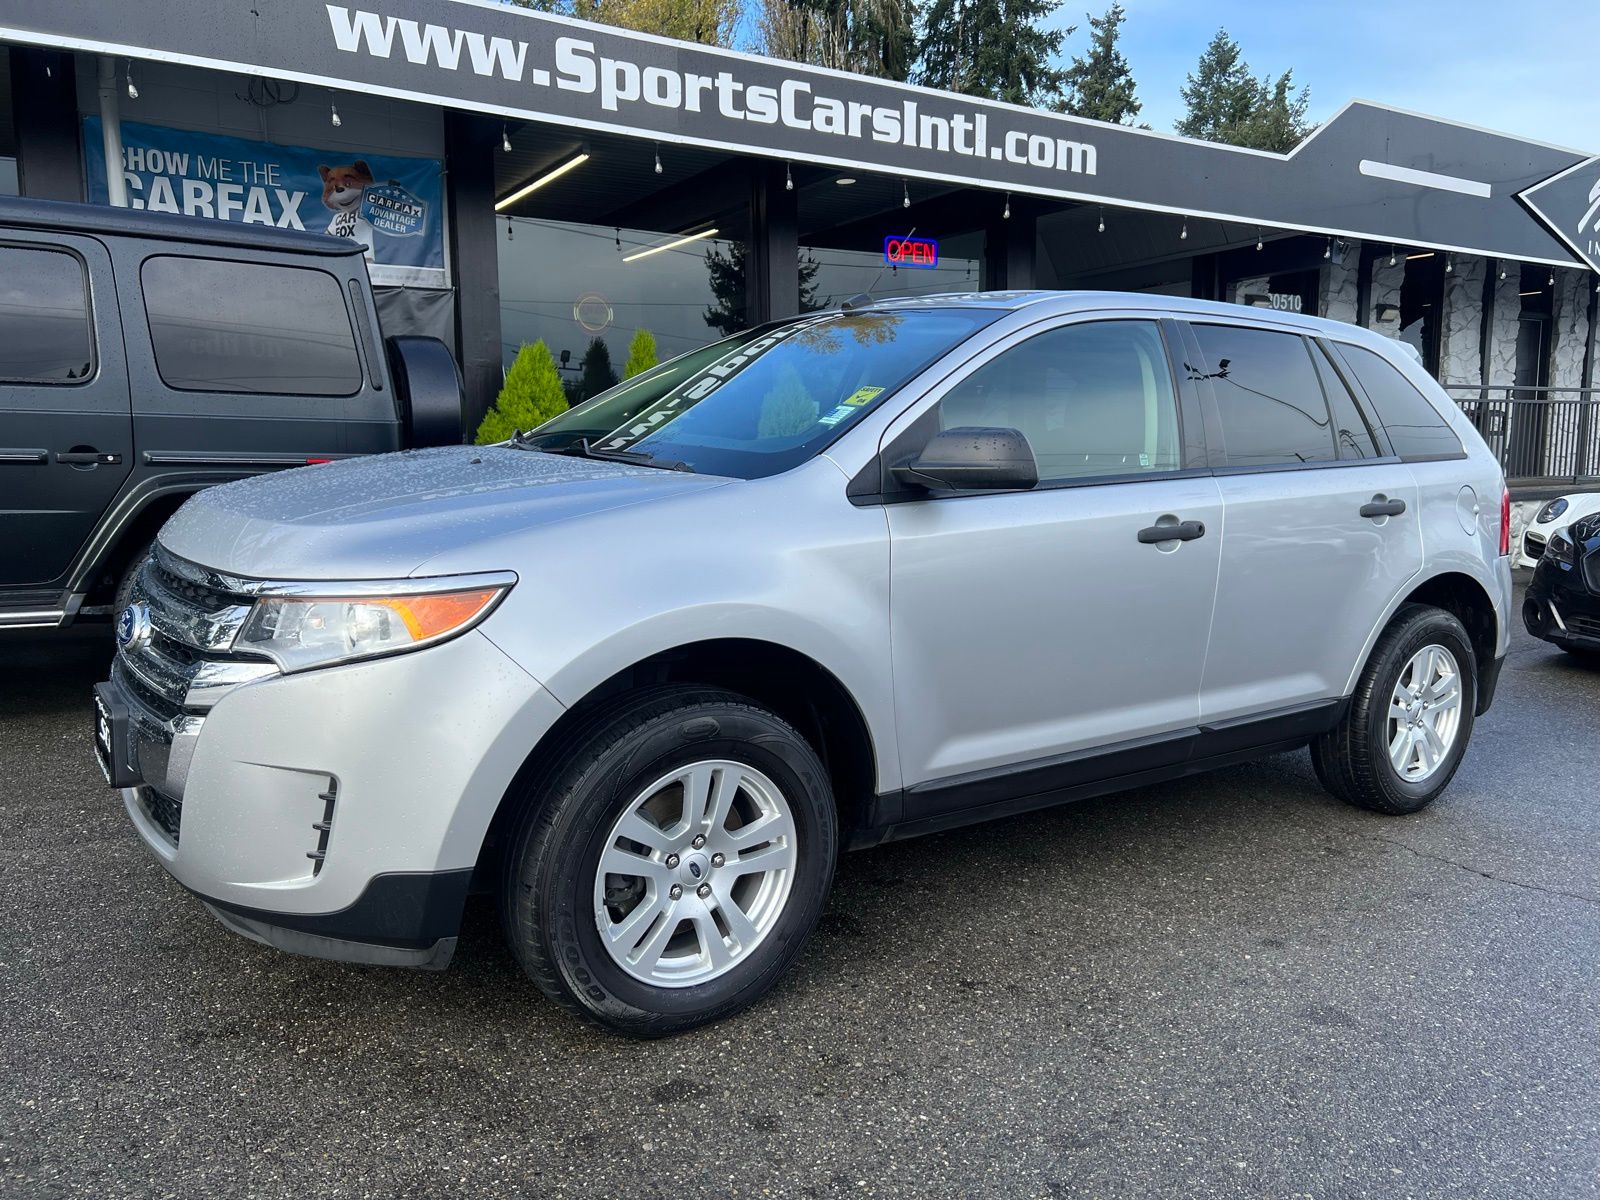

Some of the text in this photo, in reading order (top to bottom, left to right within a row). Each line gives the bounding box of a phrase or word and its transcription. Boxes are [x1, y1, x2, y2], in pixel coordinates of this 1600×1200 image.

[197, 155, 233, 181] ME
[238, 161, 281, 187] THE
[368, 193, 421, 217] CARFAX
[335, 212, 356, 225] CAR
[369, 206, 416, 226] ADVANTAGE
[374, 218, 406, 233] DEALER
[335, 225, 355, 237] FOX
[888, 240, 935, 265] OPEN
